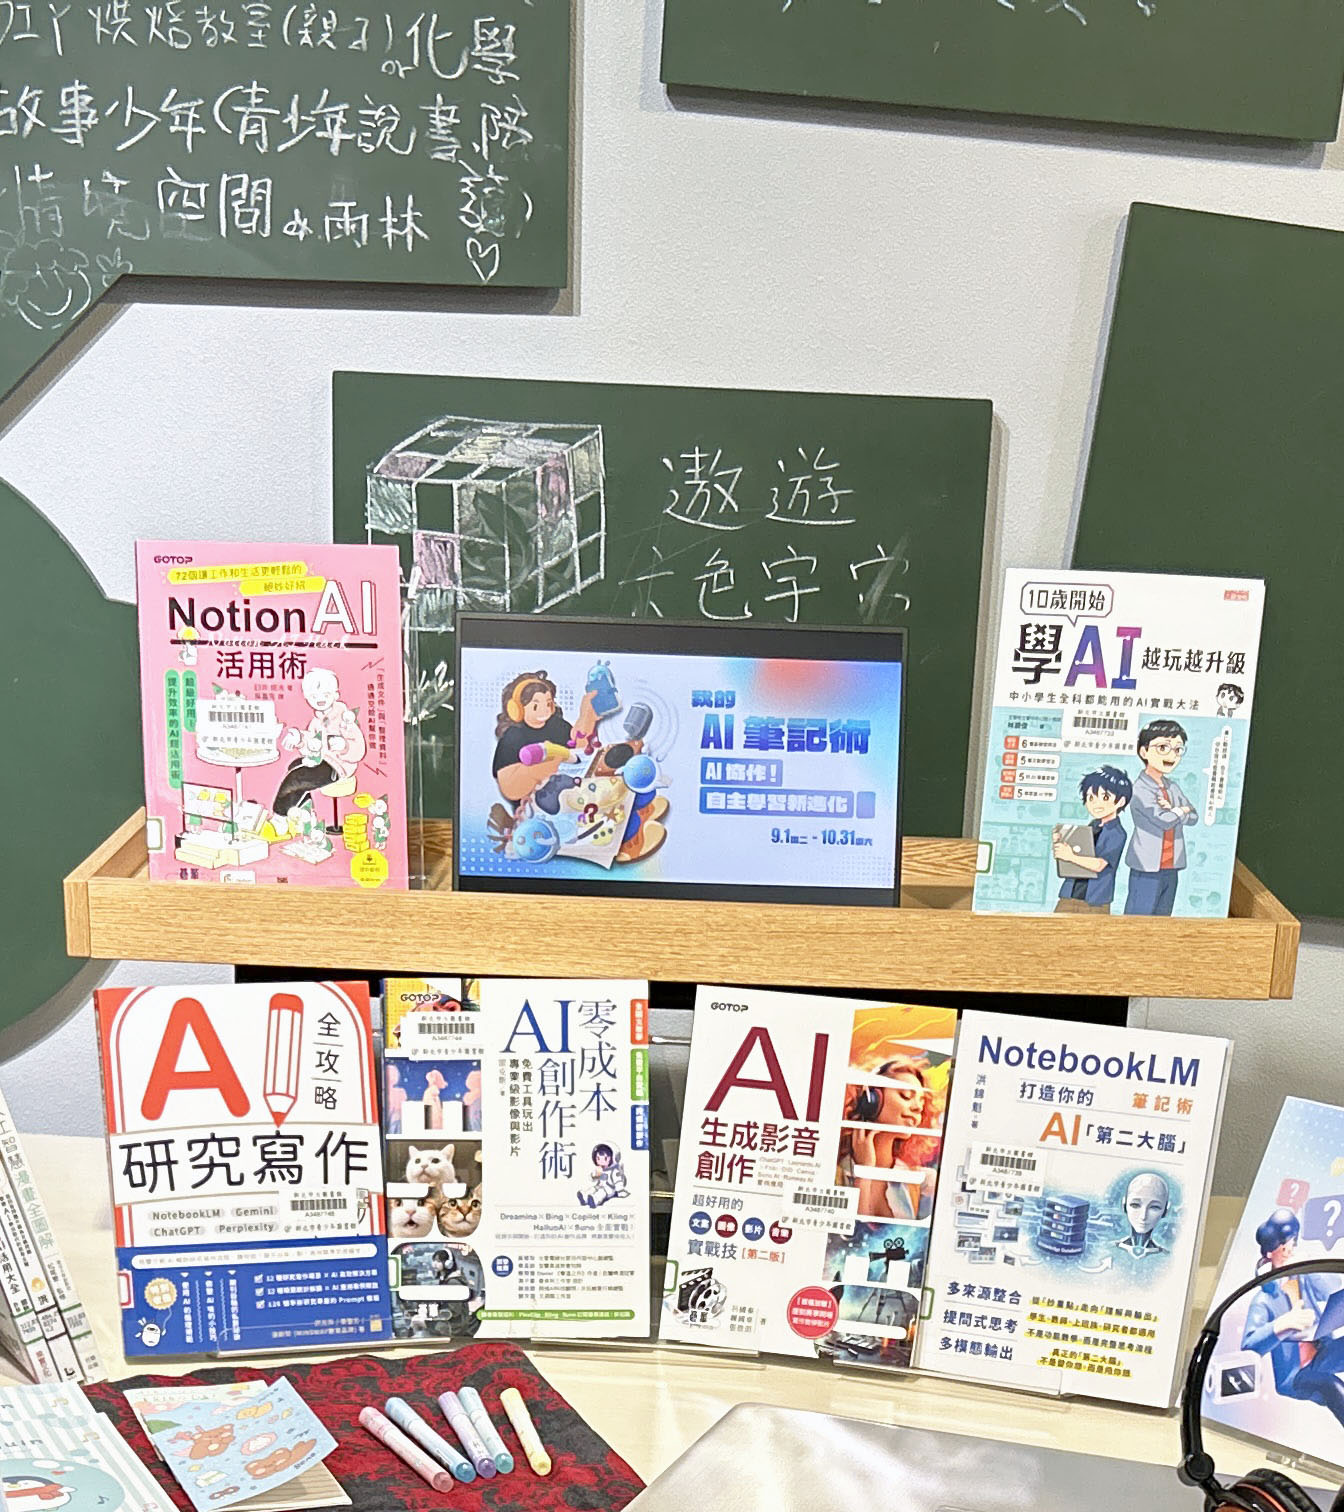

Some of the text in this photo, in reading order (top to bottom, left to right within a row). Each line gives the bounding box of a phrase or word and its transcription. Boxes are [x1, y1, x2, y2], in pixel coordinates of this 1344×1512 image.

[662, 444, 858, 531] 遨遊
[154, 555, 193, 565] GOTOP
[168, 579, 378, 636] Notion AI
[1029, 588, 1106, 611] 10歲開始
[216, 650, 307, 680] 活用術
[1141, 646, 1247, 675] 越玩越升級
[700, 713, 872, 755] AI 筆記術
[706, 761, 723, 781] AI
[400, 993, 440, 1002] GOTOP
[710, 1001, 749, 1013] GOTOP
[499, 999, 576, 1054] AI
[313, 1011, 342, 1110] 全攻略
[577, 999, 618, 1122] 零成本
[703, 1026, 830, 1123] AI
[978, 1035, 1201, 1088] NotebookLM
[1018, 1082, 1194, 1115] 打造你的 筆記術
[537, 1057, 578, 1180] 創作術
[1039, 1111, 1082, 1146] AI
[699, 1117, 820, 1158] 生成影音
[119, 1130, 369, 1193] 研究寫作
[694, 1150, 757, 1185] 創作
[152, 1208, 221, 1221] NotebookLM
[692, 1194, 744, 1212] 超好用的
[154, 1222, 275, 1237] ChatGPT Perplexity
[687, 1239, 739, 1261] 實戰技
[946, 1281, 1023, 1306] 多來源整合
[943, 1309, 1019, 1335] 提問式思考
[938, 1335, 1014, 1361] 多模態輸出
